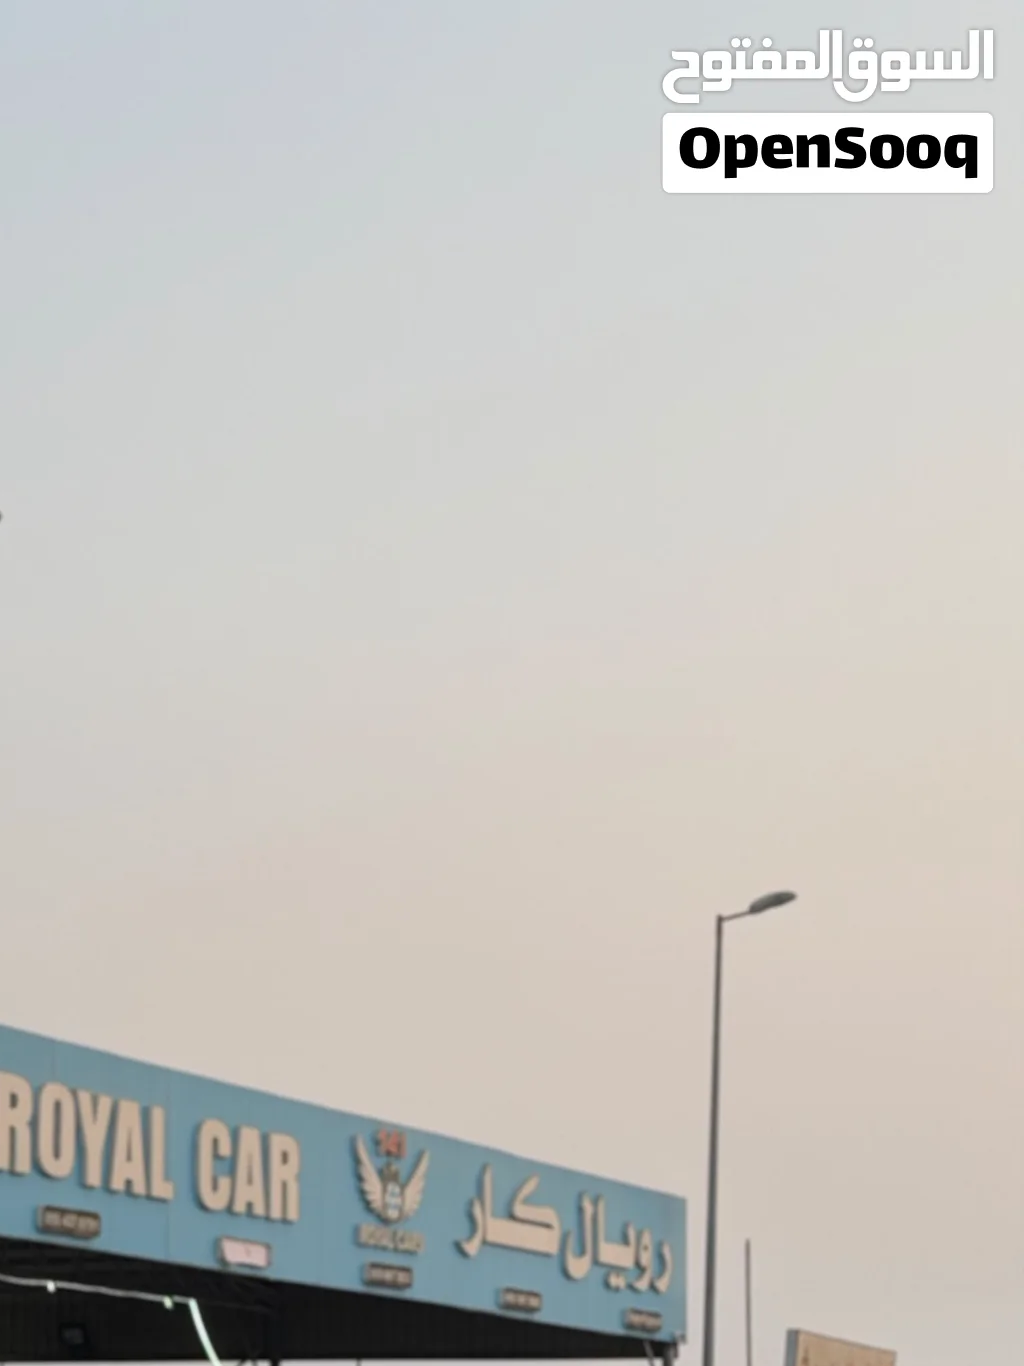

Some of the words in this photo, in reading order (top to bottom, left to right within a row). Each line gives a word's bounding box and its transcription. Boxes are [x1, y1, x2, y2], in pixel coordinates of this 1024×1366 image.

[195, 1119, 300, 1222] CAR
[454, 1163, 562, 1258] كار
[564, 1192, 673, 1295] رويال
